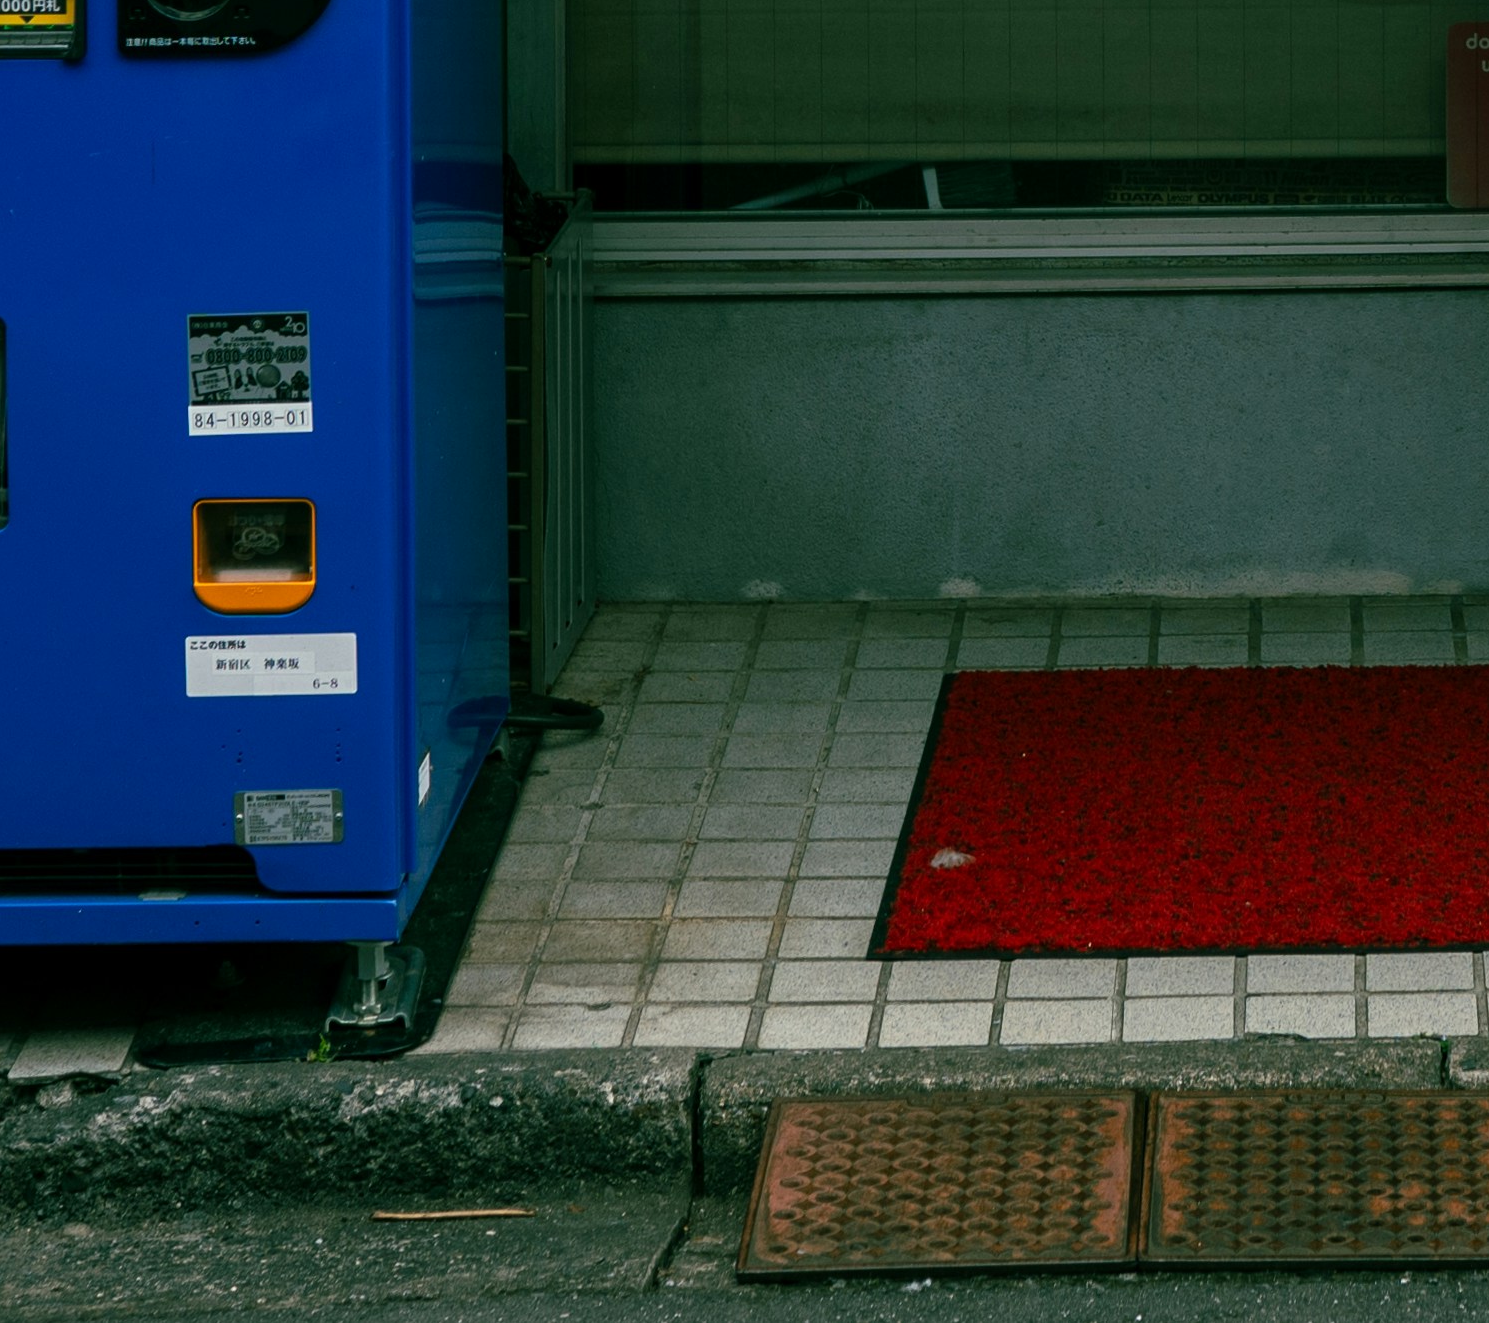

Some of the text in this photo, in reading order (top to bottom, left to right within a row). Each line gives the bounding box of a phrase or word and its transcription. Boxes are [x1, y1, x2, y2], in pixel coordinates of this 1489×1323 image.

[194, 409, 306, 429] 84-1998-01
[189, 639, 247, 651] ここの住所は
[215, 657, 300, 671] 新宿区 神楽坂
[312, 678, 340, 690] 6-8
